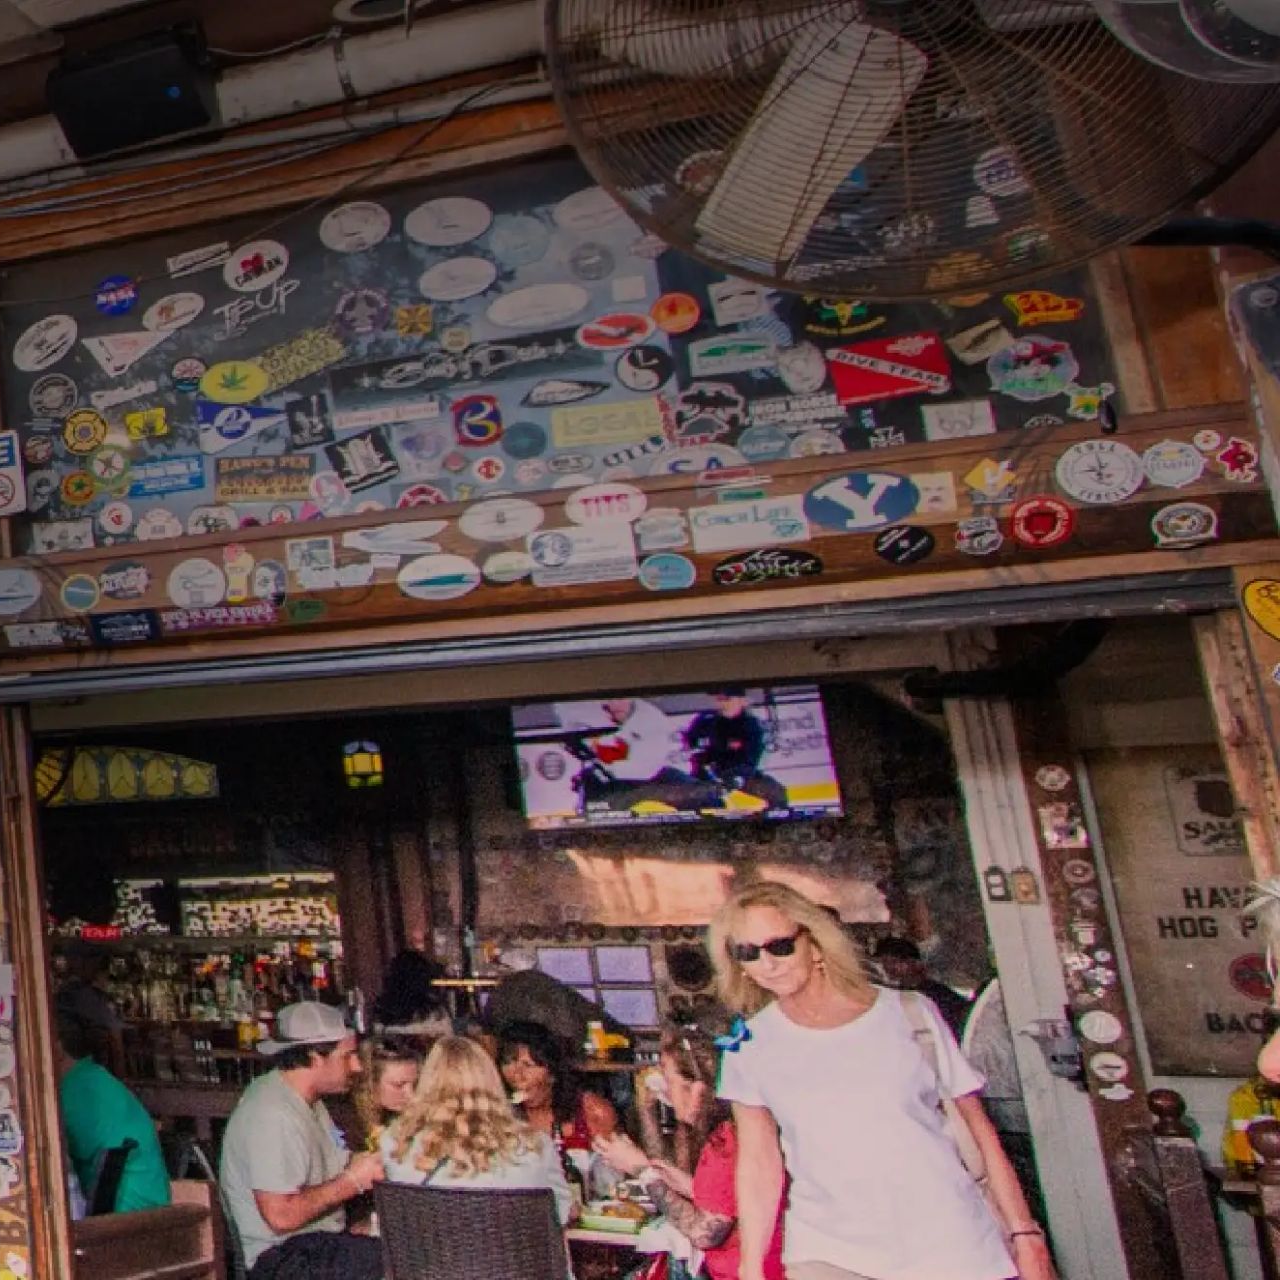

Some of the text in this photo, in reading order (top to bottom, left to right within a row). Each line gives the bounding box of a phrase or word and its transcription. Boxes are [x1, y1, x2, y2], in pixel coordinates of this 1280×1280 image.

[837, 352, 944, 383] DIVE TEAM
[812, 472, 901, 528] Y
[1158, 917, 1218, 939] HOG
